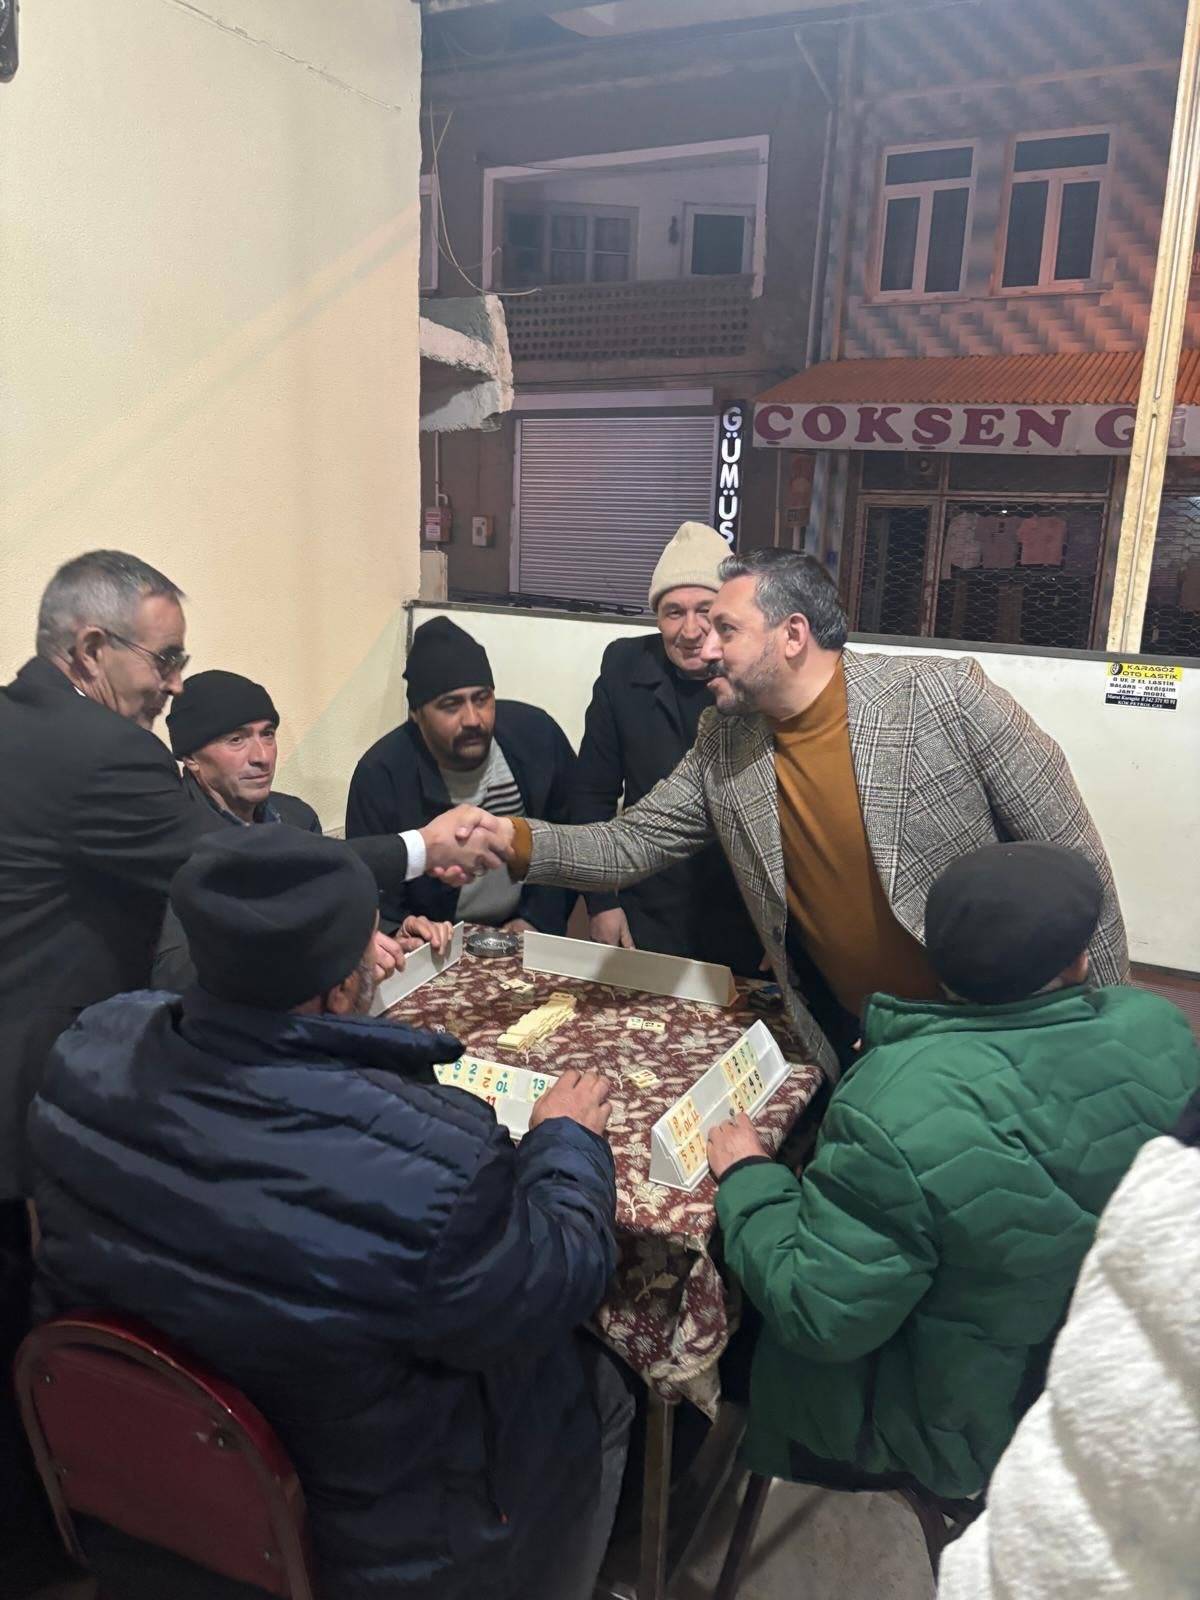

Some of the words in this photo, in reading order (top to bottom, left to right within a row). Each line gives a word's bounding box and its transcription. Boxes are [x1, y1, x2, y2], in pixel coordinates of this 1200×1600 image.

[1127, 664, 1175, 673] KARAGÖZ
[1122, 670, 1142, 678] OTO
[455, 1060, 462, 1072] 6
[469, 1063, 479, 1076] 2
[533, 1077, 546, 1091] 13
